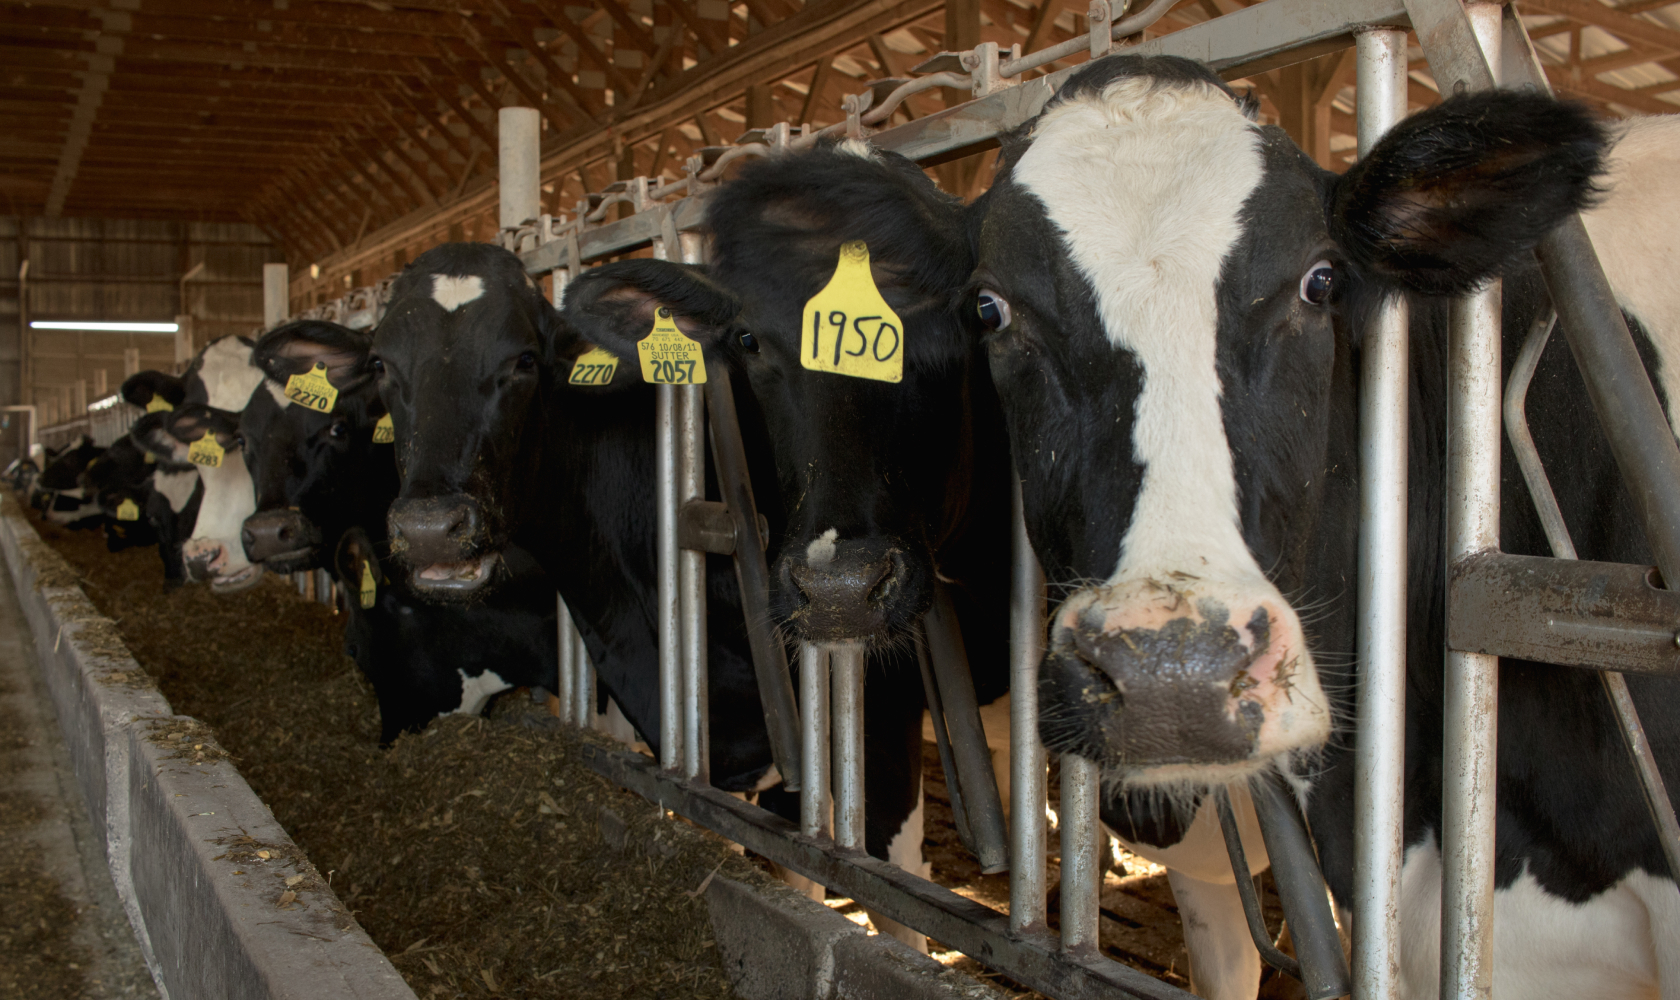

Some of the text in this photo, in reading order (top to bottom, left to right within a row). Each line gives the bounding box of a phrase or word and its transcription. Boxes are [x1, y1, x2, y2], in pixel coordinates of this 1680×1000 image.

[641, 342, 698, 352] 576 10/08/11
[812, 310, 900, 367] 1950
[651, 351, 689, 360] SUTTER
[570, 363, 613, 384] 2270
[650, 360, 696, 384] 2057
[291, 387, 328, 410] 2270
[192, 452, 218, 467] 2283
